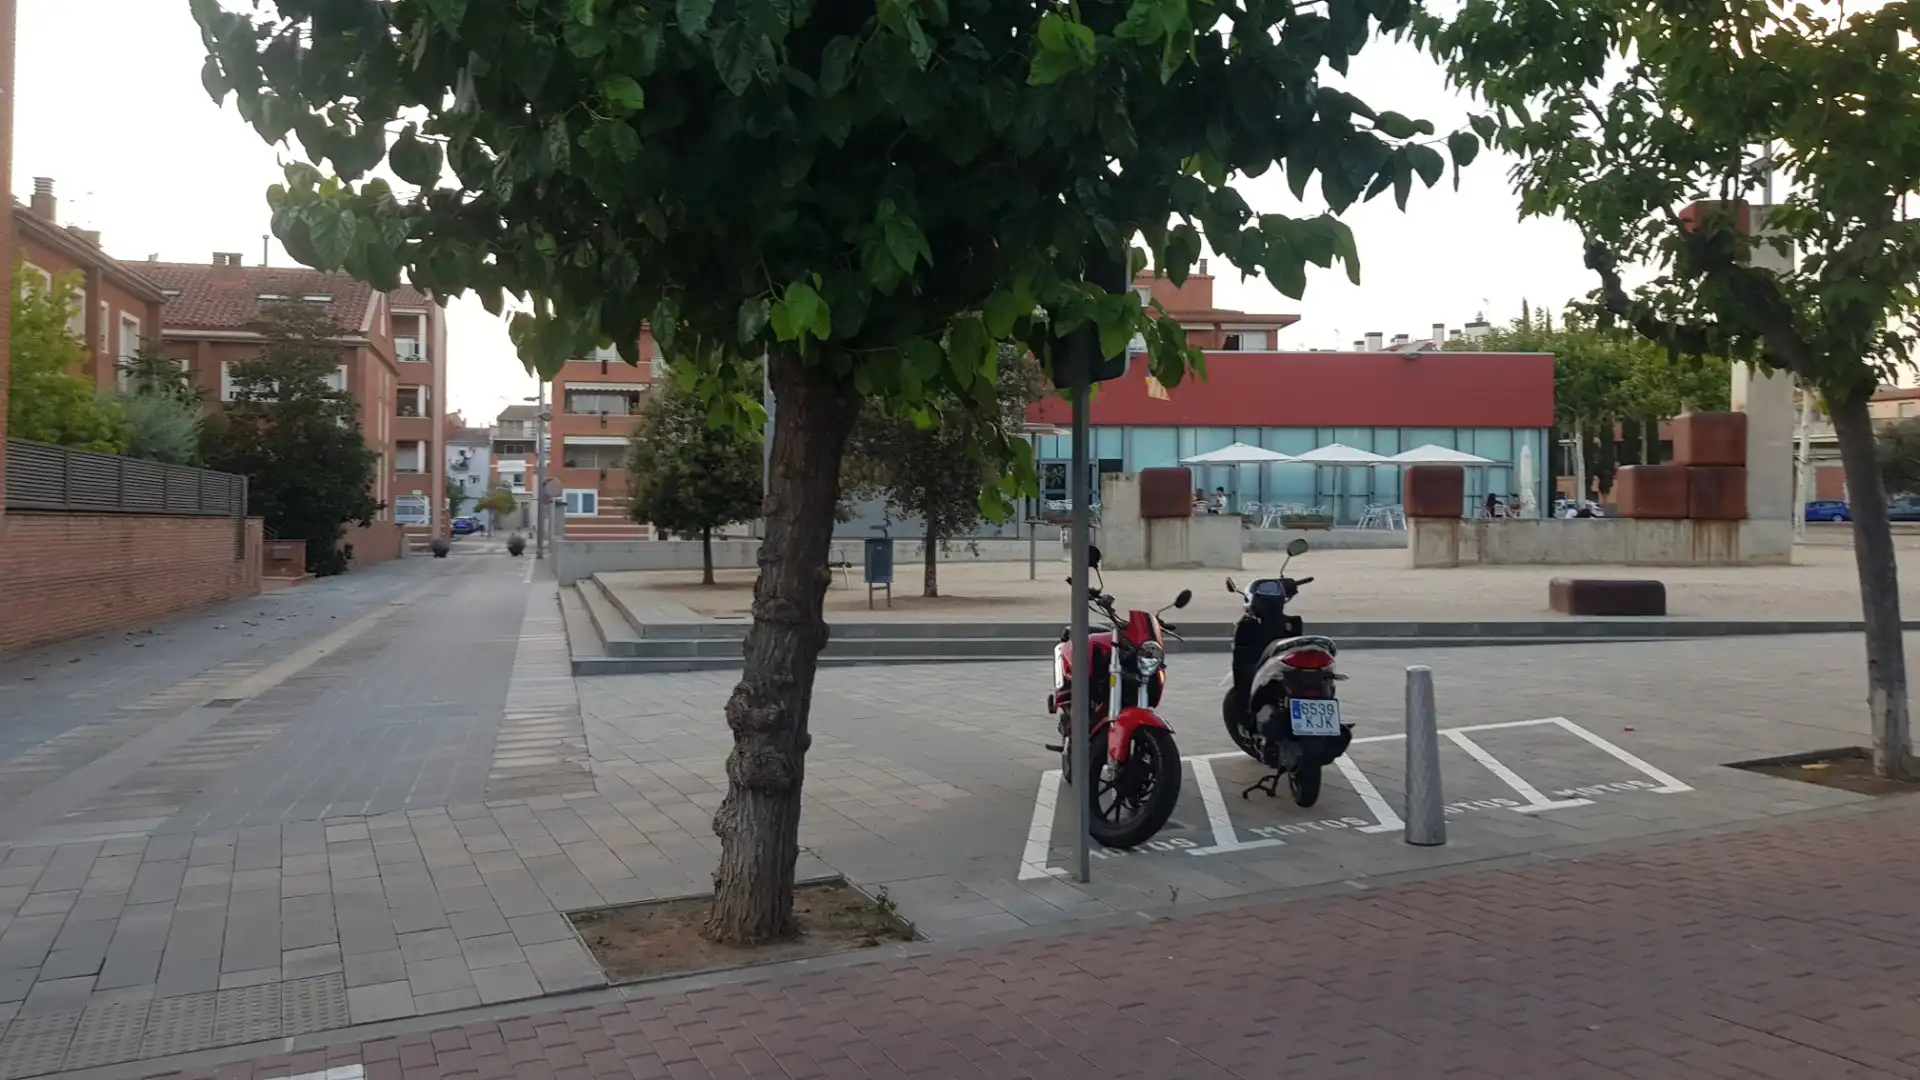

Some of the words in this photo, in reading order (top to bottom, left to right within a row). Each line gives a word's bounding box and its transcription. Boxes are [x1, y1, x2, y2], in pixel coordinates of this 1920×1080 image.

[1301, 703, 1334, 716] 6539
[1306, 715, 1333, 729] KJK
[1551, 780, 1656, 796] MOTOS
[1443, 798, 1520, 815] OTOS
[1249, 817, 1369, 838] MOTOS
